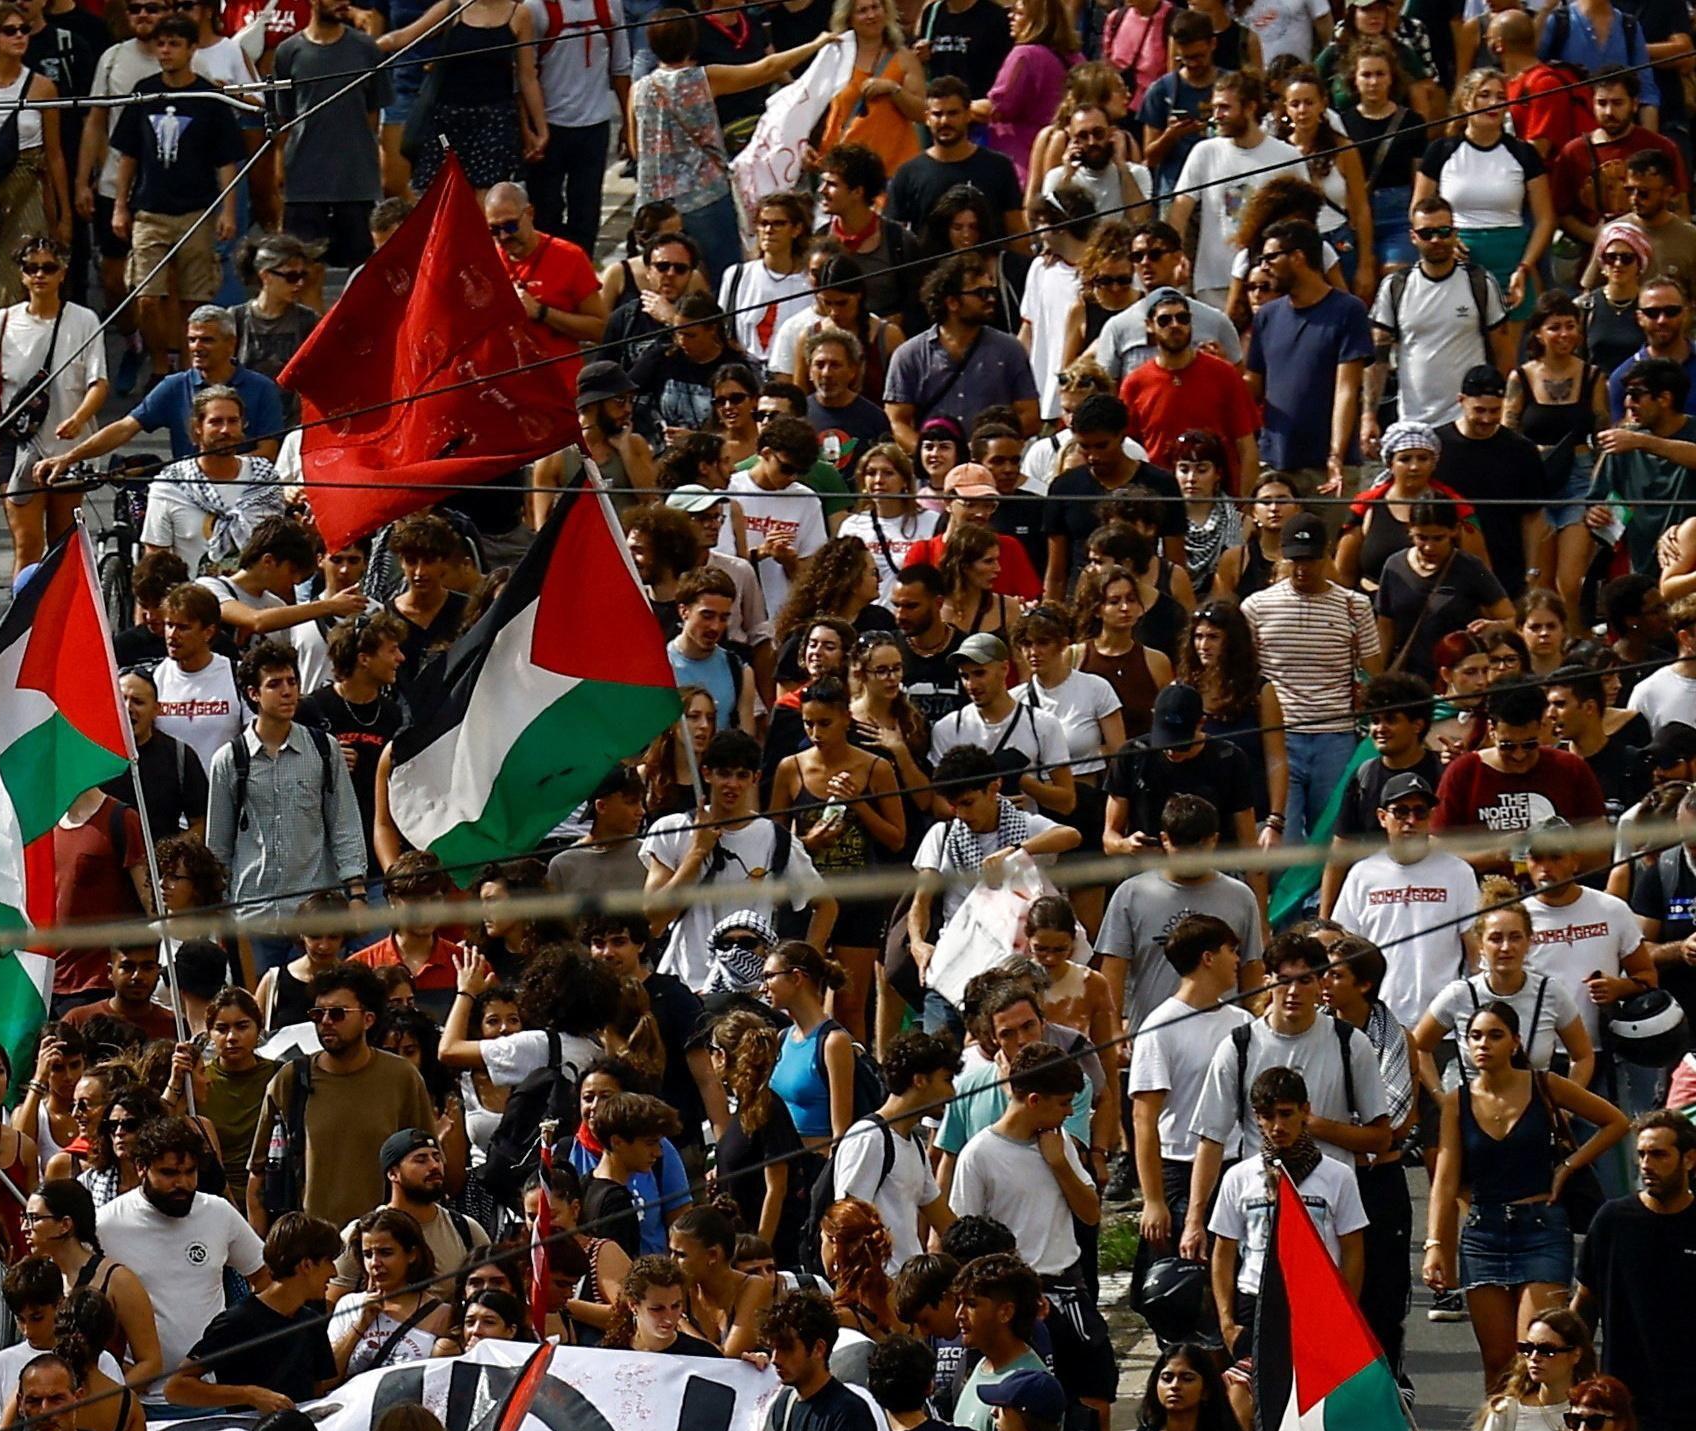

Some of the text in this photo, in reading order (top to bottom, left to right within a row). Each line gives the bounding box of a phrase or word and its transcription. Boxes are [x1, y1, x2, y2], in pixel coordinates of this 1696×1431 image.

[157, 702, 185, 716] OMA
[1498, 794, 1527, 805] THE
[1479, 806, 1529, 821] NORTH
[1487, 819, 1531, 830] WEST
[1369, 888, 1446, 906] ROMA GAZA
[1573, 922, 1609, 941] GAZA
